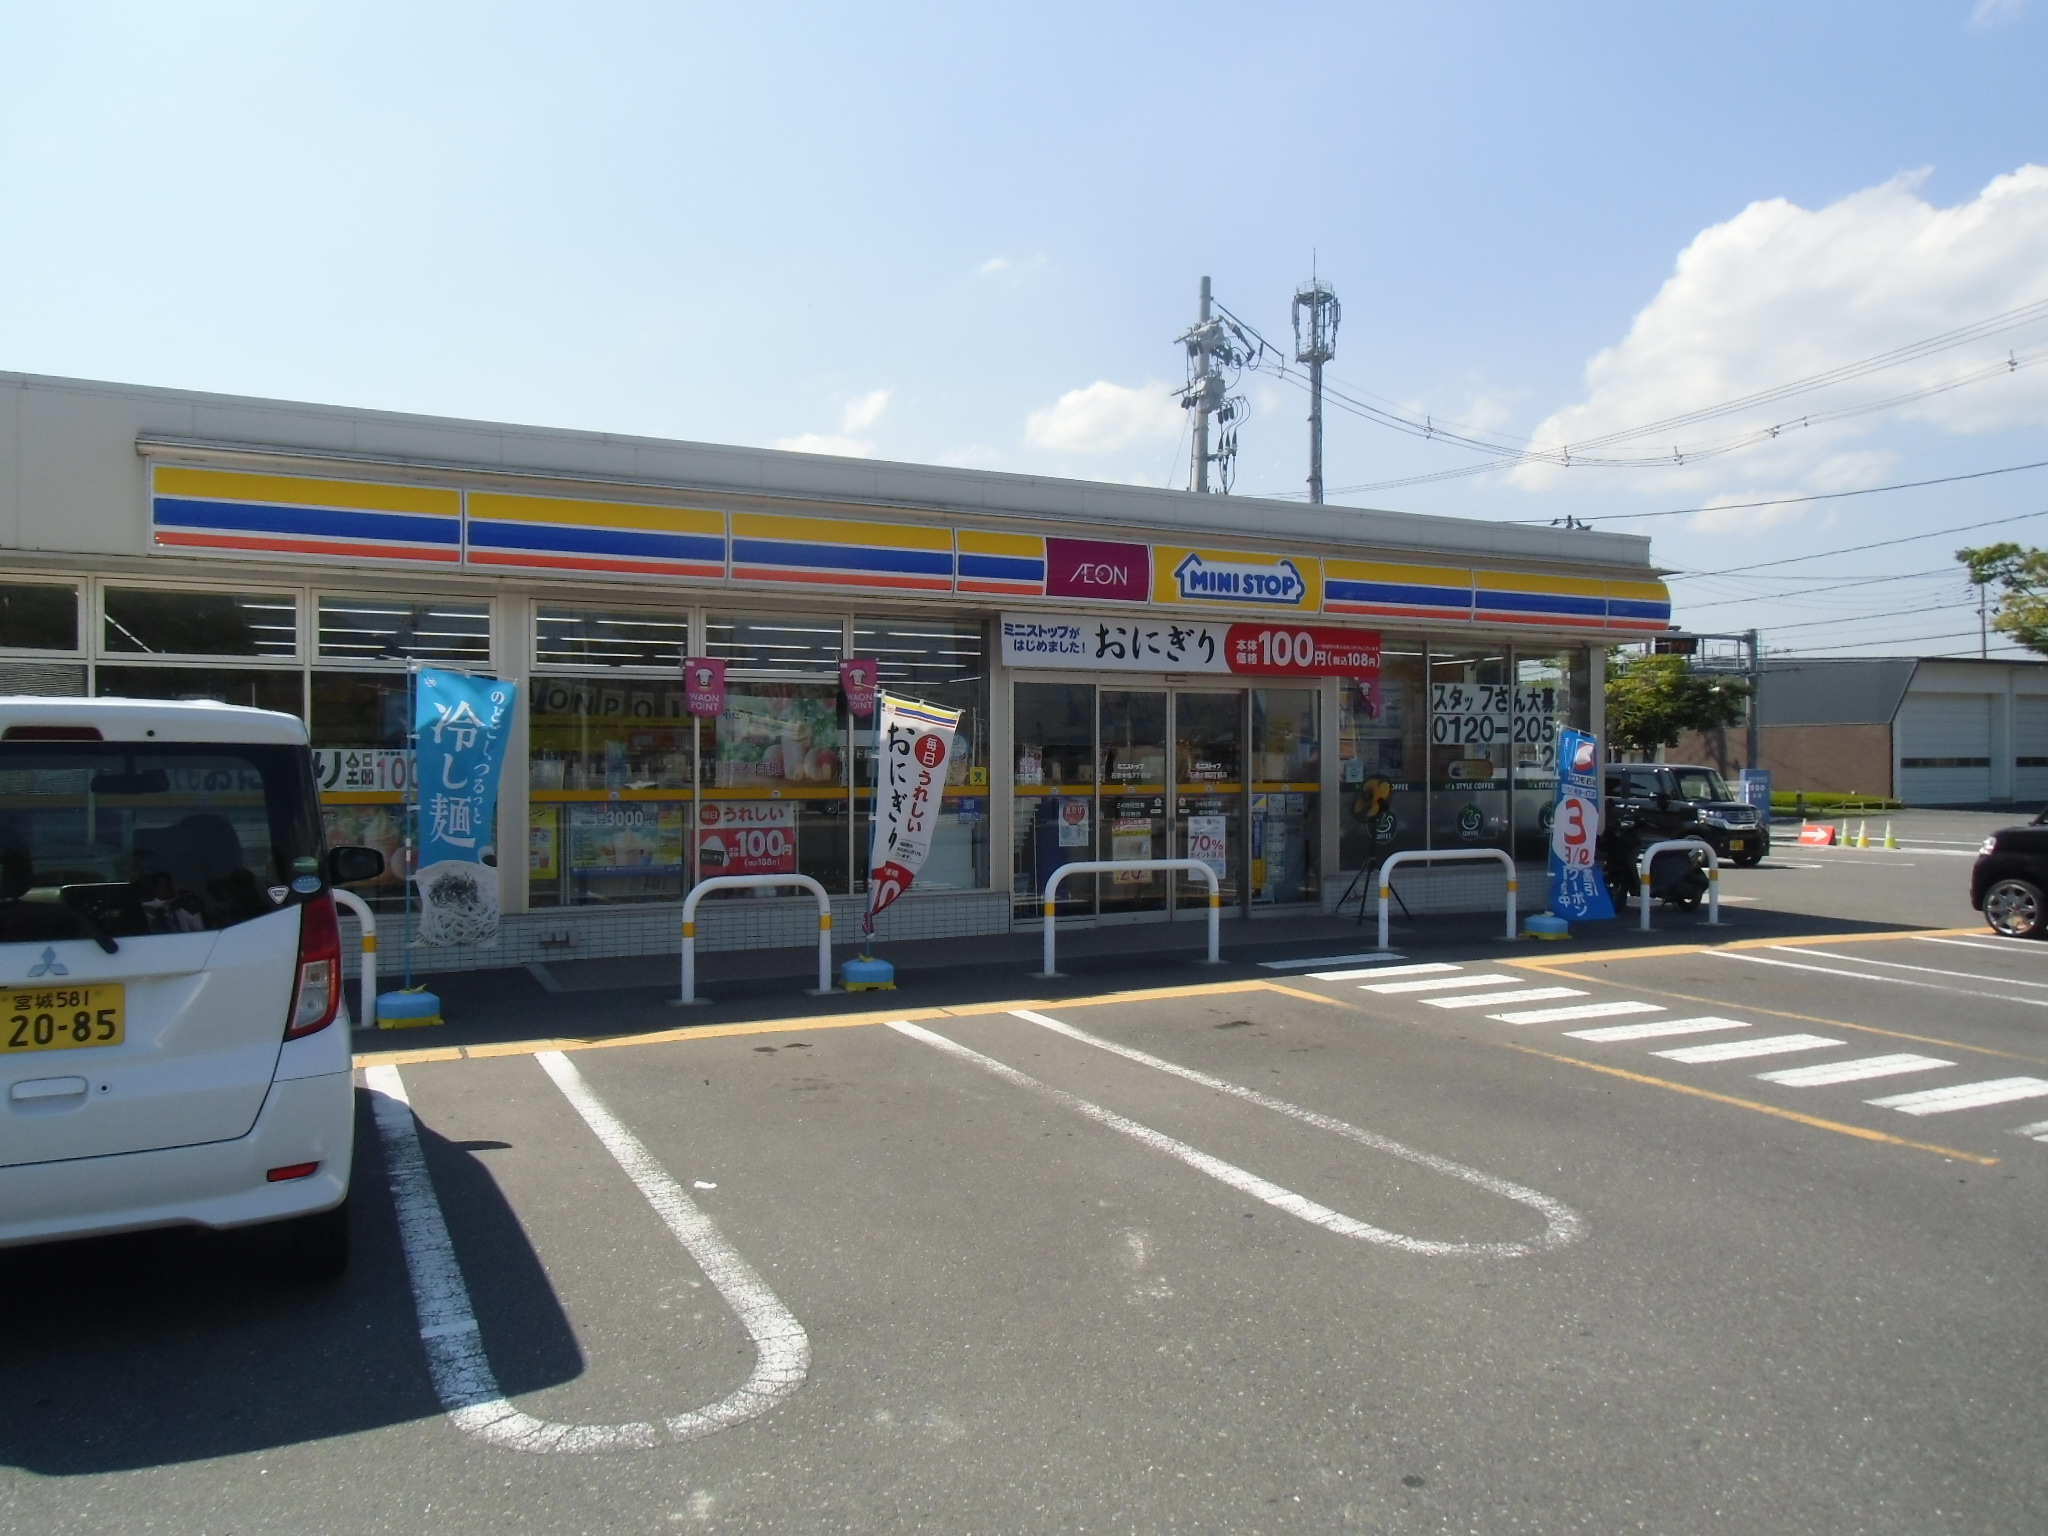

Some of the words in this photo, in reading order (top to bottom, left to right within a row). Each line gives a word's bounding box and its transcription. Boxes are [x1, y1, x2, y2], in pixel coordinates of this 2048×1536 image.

[1190, 570, 1239, 593] MINI
[1243, 573, 1295, 596] STOP
[1004, 622, 1080, 639] ミニストップが
[1095, 622, 1215, 664] おにぎり
[1014, 639, 1086, 654] はじめました!
[1236, 640, 1257, 651] 本体
[1236, 653, 1257, 665] 価格
[689, 692, 720, 703] WAON
[690, 702, 719, 711] POINT
[923, 736, 938, 766] 毎日
[429, 700, 488, 848] 冷し麺
[888, 721, 916, 853] おにぎり
[1474, 782, 1495, 790] COFFEE
[724, 806, 784, 822] うれしい
[907, 769, 933, 833] うれしい
[1564, 798, 1587, 845] 3
[735, 829, 792, 857] 100円
[1189, 835, 1224, 851] 70%
[1568, 868, 1588, 917] クーポン
[8, 1008, 116, 1048] 20-85
